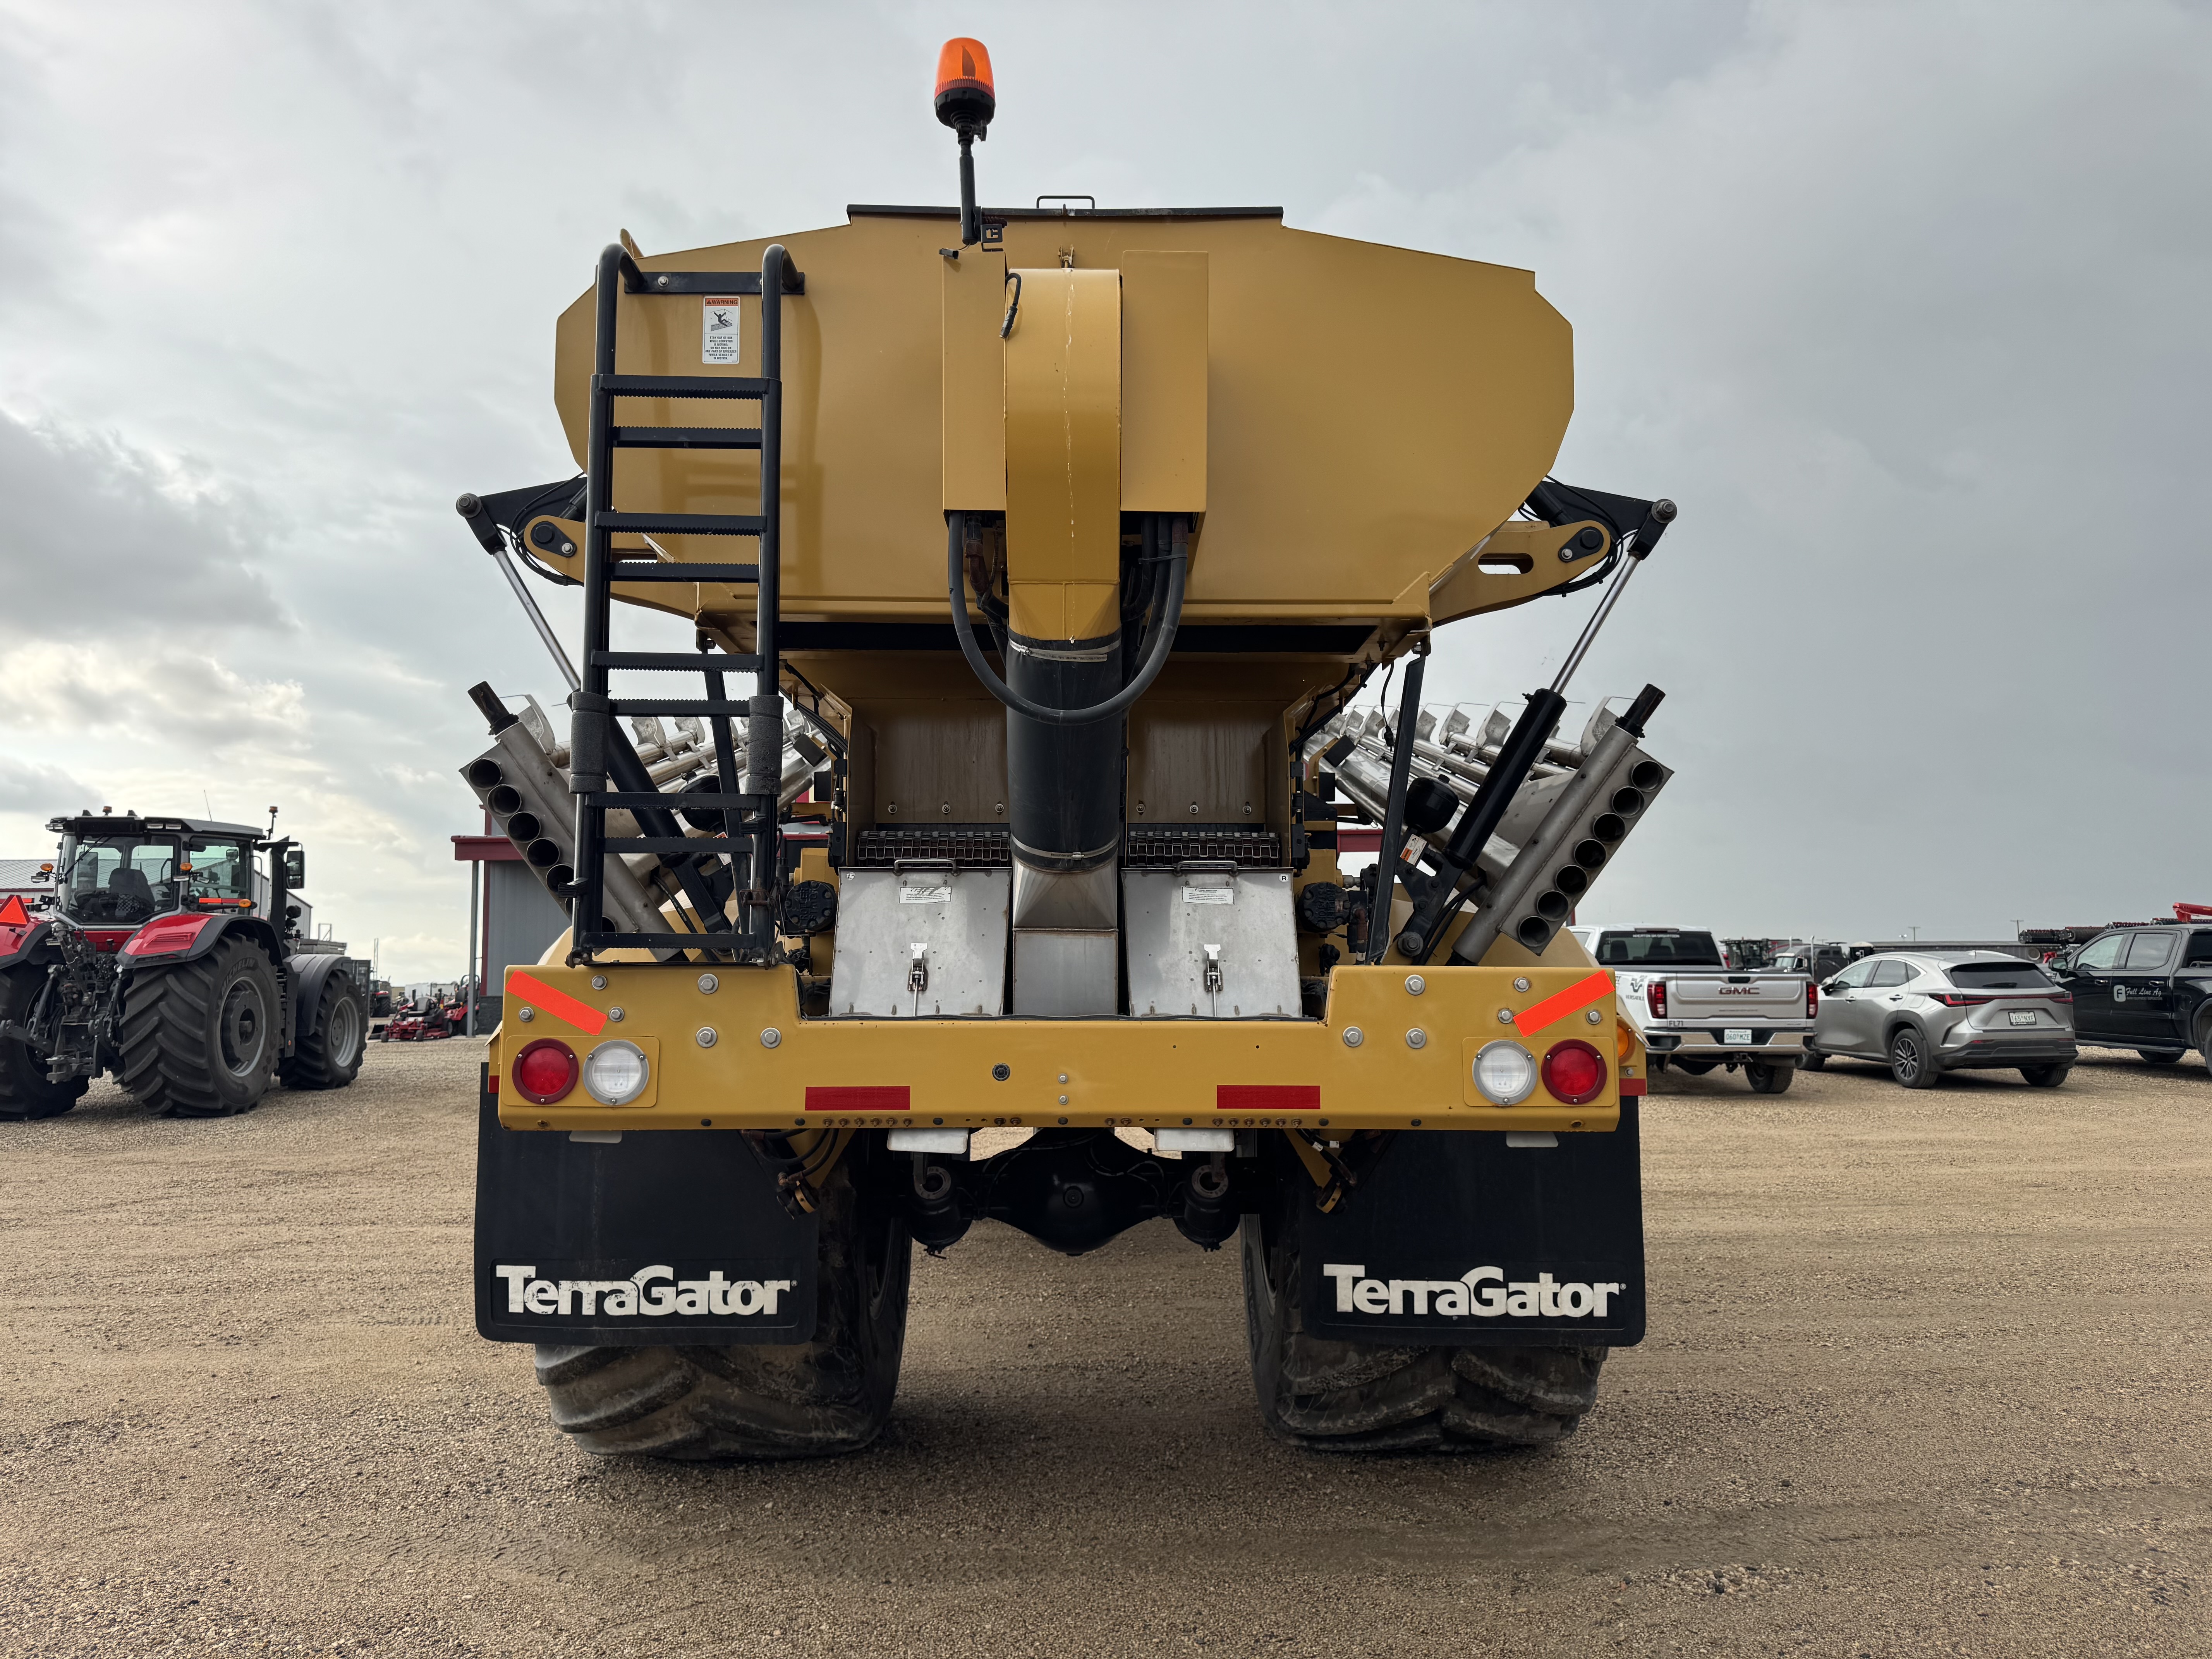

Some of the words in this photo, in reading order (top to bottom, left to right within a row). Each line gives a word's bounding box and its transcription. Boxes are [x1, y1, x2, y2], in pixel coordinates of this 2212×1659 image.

[221, 957, 256, 996] MICHELIN
[2126, 988, 2138, 996] Full
[2153, 988, 2162, 997] Ag
[496, 1265, 790, 1316] TerraGator
[1323, 1264, 1620, 1317] TerraGator
